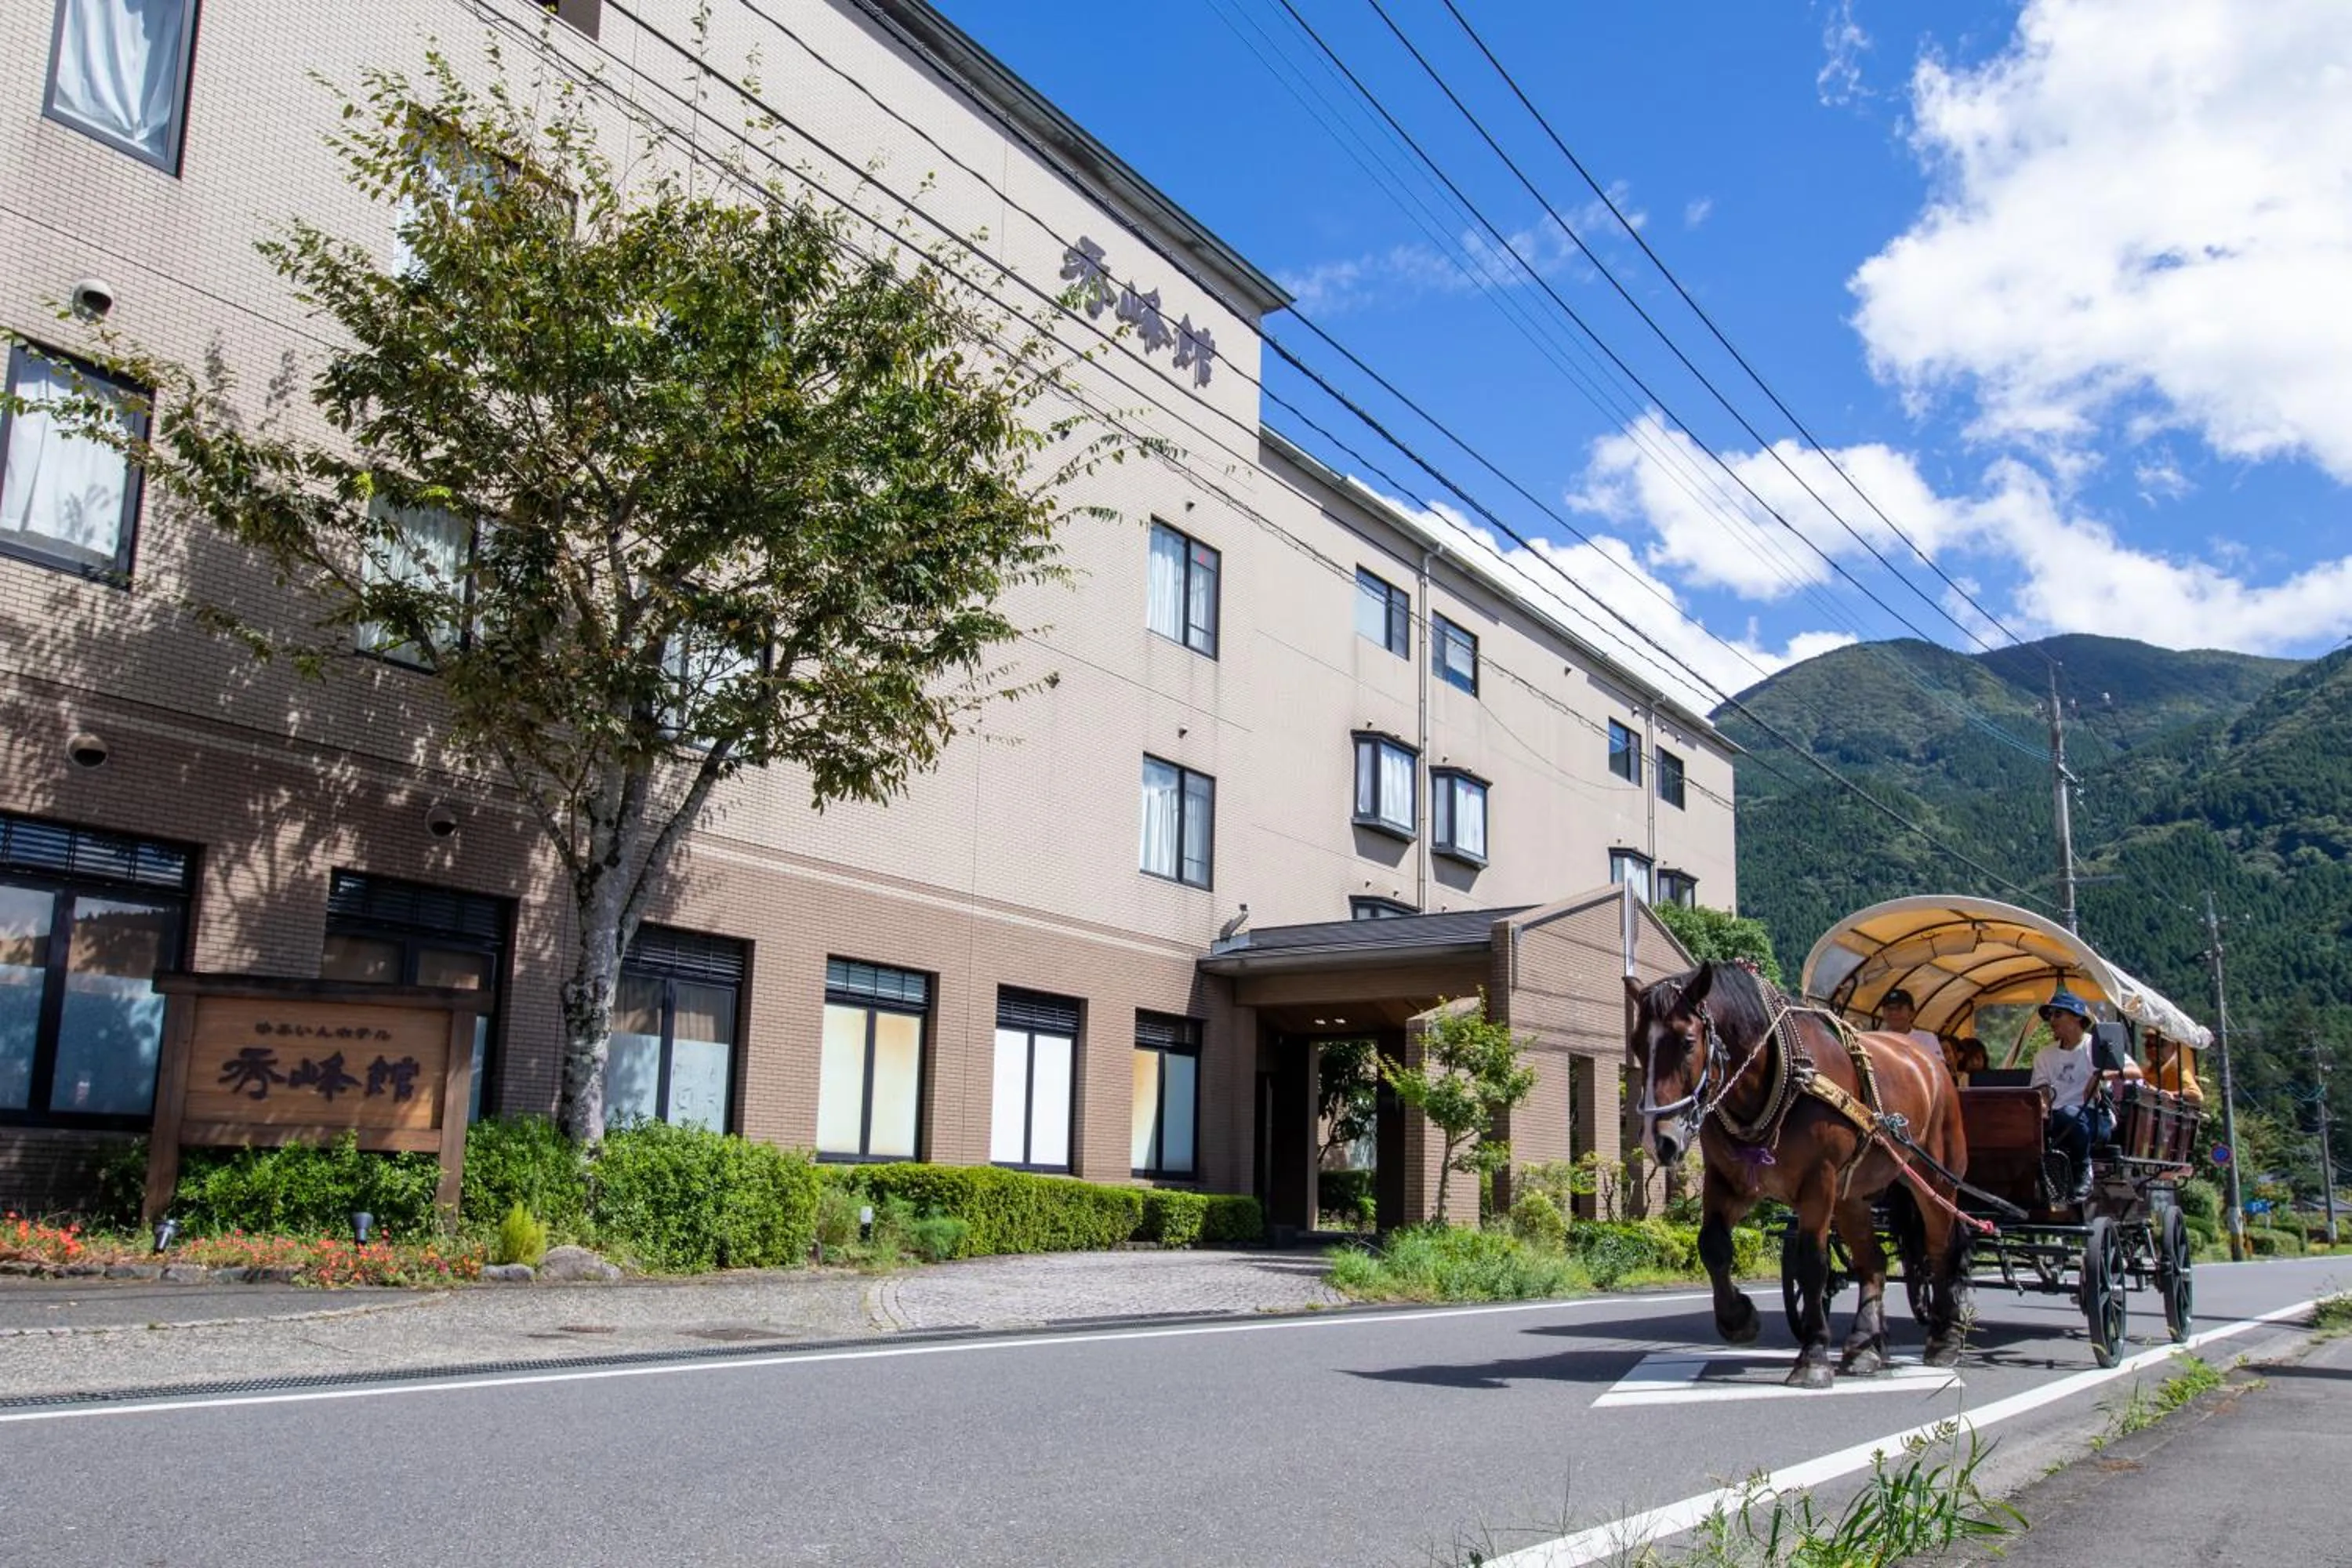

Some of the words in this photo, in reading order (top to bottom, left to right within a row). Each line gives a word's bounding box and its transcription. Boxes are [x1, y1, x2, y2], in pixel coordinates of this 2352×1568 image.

[1060, 236, 1215, 389] 秀峰館
[219, 1047, 420, 1102] 秀峰館
